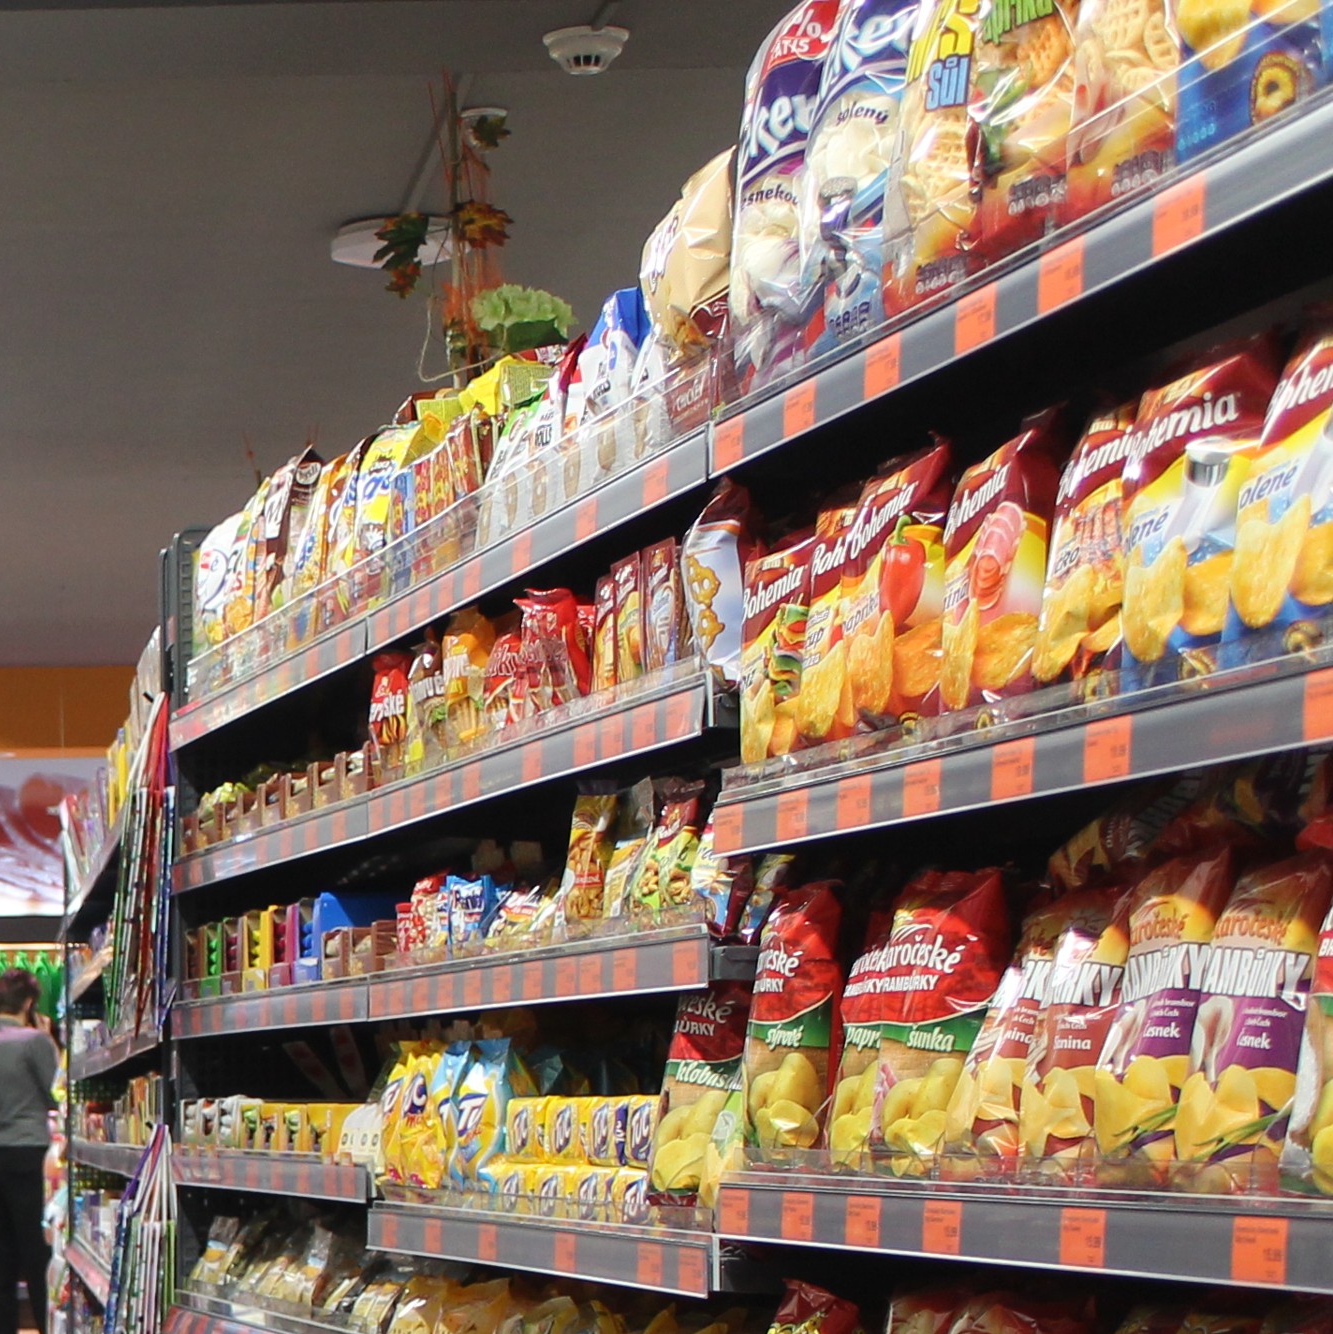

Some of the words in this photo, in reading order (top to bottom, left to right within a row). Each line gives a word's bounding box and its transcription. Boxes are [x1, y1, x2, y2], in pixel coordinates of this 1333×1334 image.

[926, 56, 971, 110] Sůl
[1127, 391, 1239, 466] Bohemia
[851, 481, 920, 559] Bohemia
[943, 462, 1011, 545] Bohemia
[741, 564, 808, 623] Bohemia
